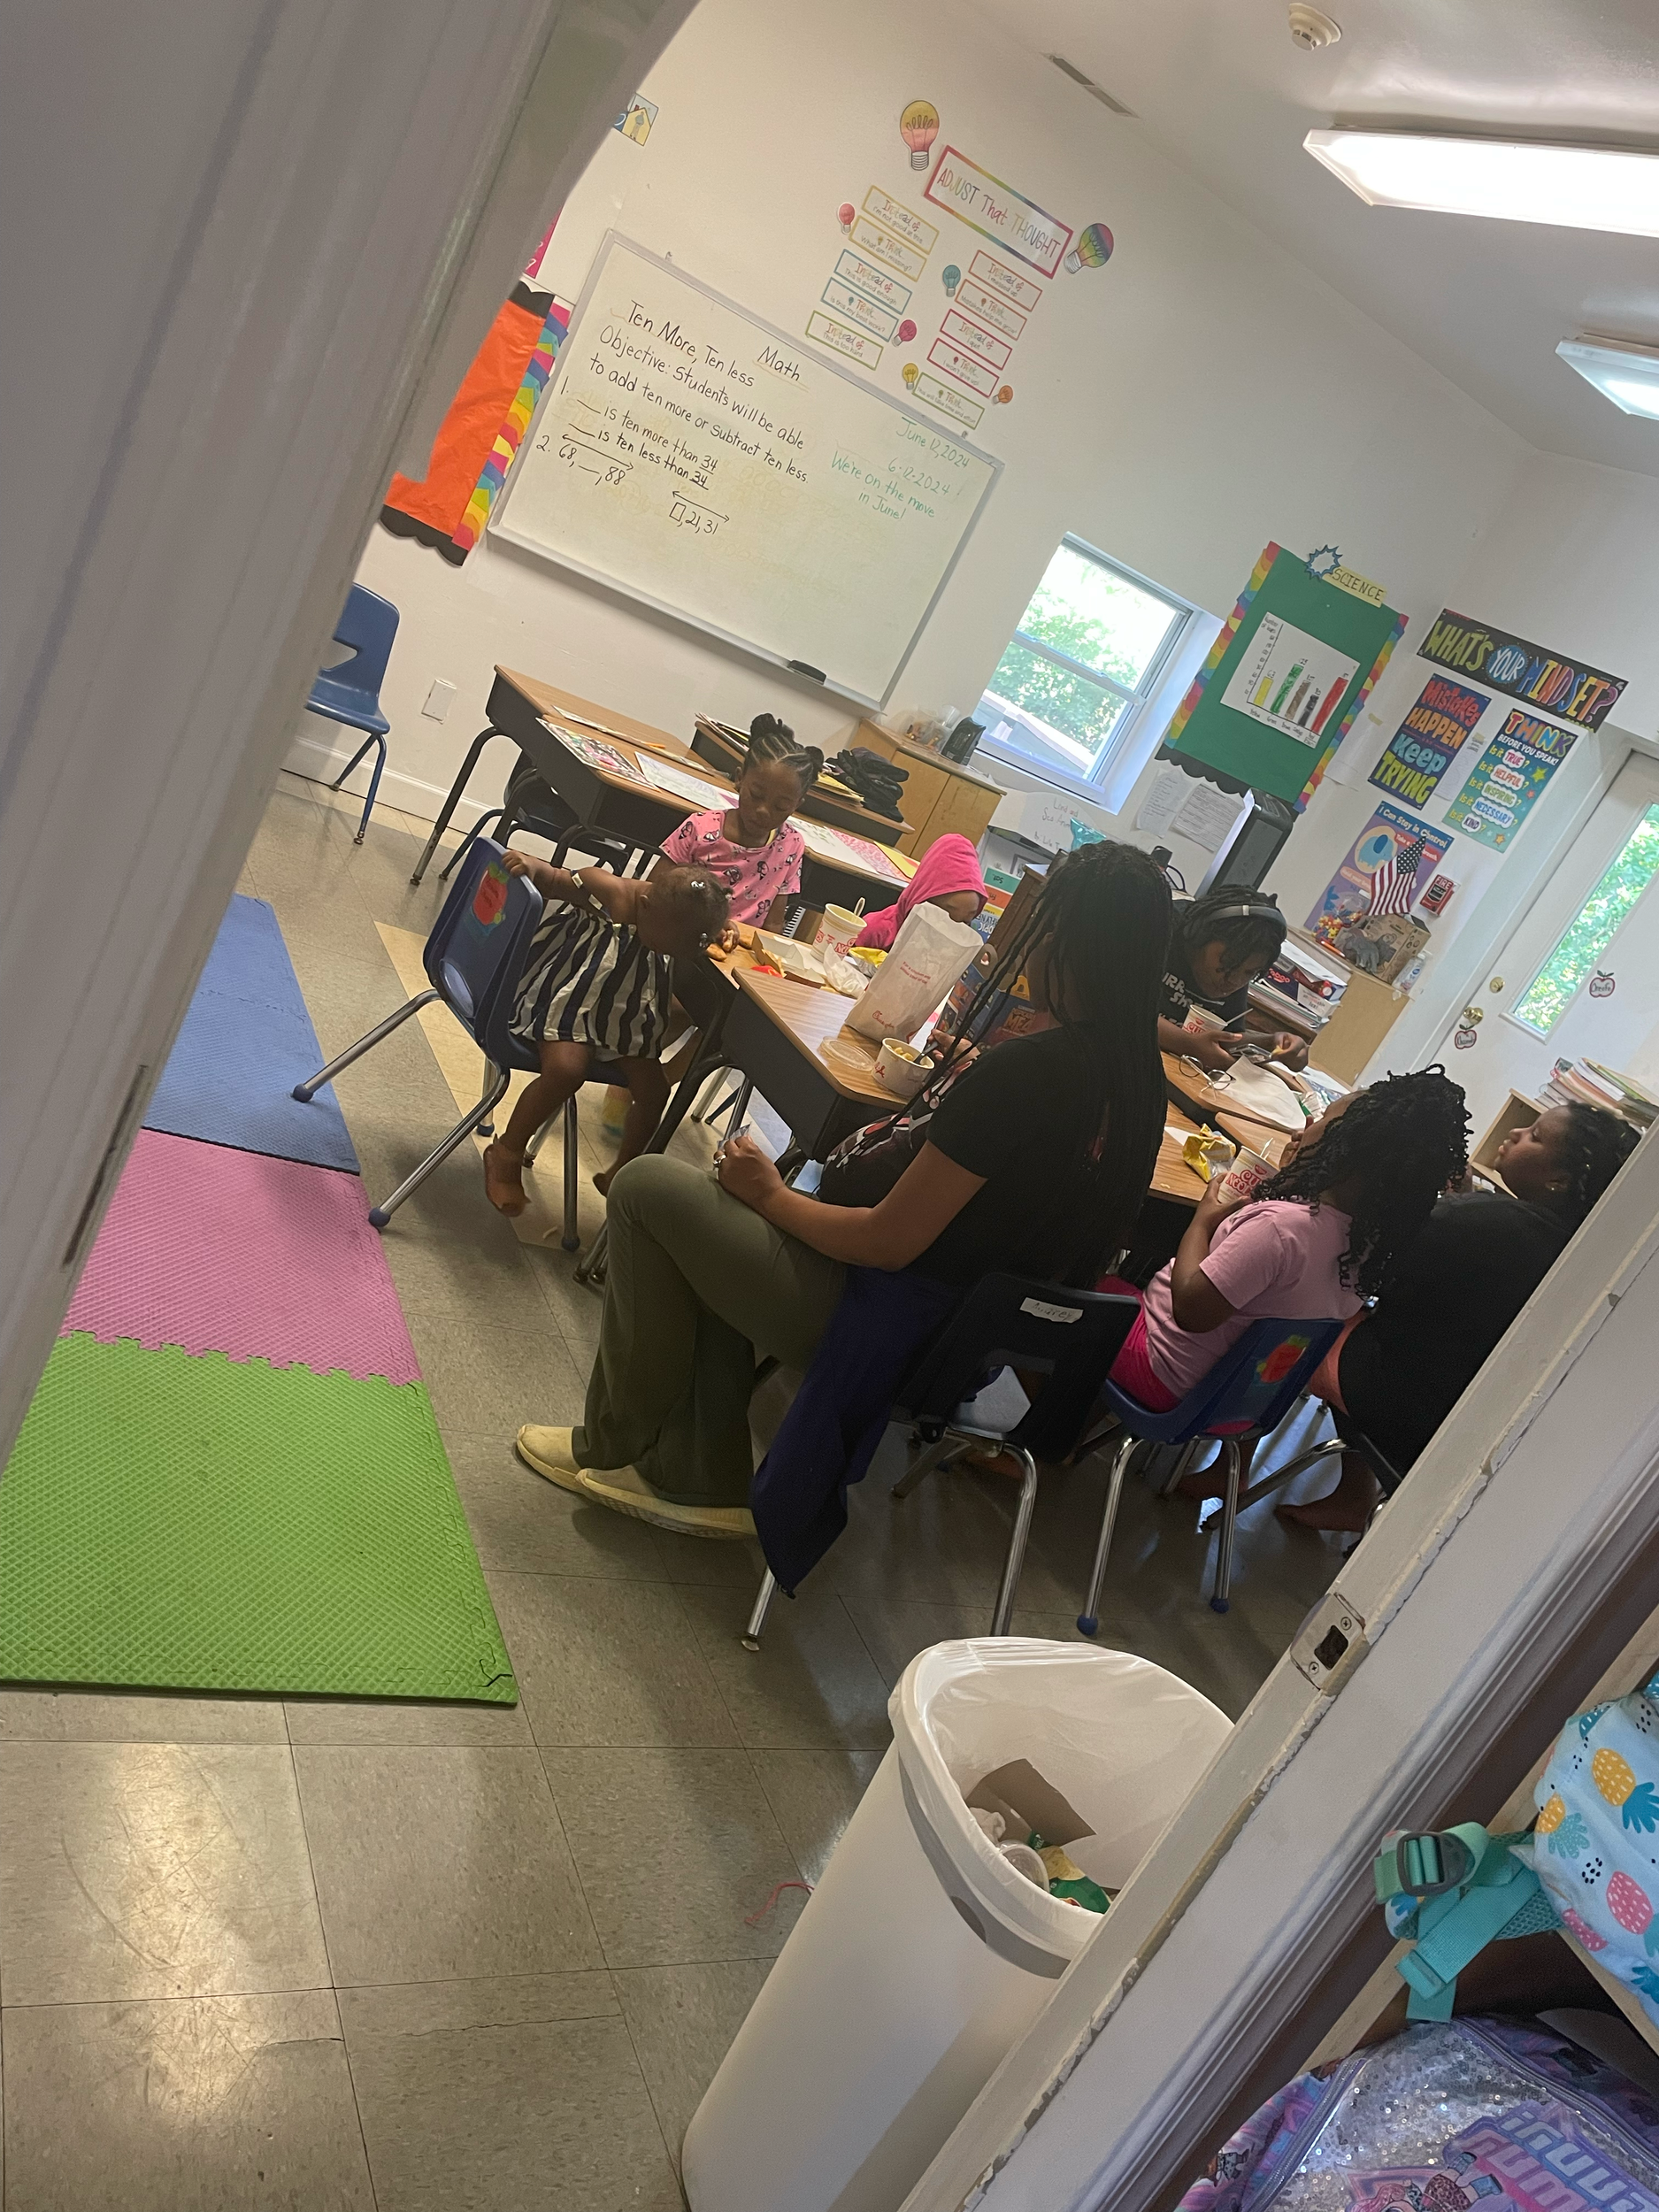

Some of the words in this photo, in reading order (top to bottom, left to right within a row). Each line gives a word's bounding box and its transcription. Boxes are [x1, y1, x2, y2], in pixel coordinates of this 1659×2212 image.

[937, 168, 980, 204] ADJUST
[981, 195, 1008, 226] That
[1010, 213, 1061, 258] THOUGHT
[861, 235, 875, 250] What
[861, 280, 877, 293] good
[876, 289, 897, 306] enough
[628, 300, 654, 333] Ten
[657, 321, 697, 364] More,
[704, 345, 725, 372] Ten
[727, 359, 755, 387] less
[757, 346, 801, 381] Math
[600, 325, 671, 374] Objective:
[672, 366, 729, 406] Students
[732, 401, 758, 422] will
[758, 412, 773, 432] be
[777, 427, 803, 449] able
[590, 353, 604, 374] to
[609, 372, 638, 392] add
[642, 382, 663, 405] ten
[664, 401, 692, 422] more
[695, 418, 709, 429] or
[764, 448, 782, 471] ten
[786, 458, 809, 483] less.
[895, 417, 926, 447] June
[604, 401, 618, 420] is
[622, 410, 639, 433] ten
[642, 428, 669, 448] more
[673, 438, 698, 463] than
[700, 455, 718, 472] 34
[598, 423, 611, 442] is
[617, 433, 634, 452] ten
[639, 442, 661, 465] less
[664, 455, 689, 479] than
[693, 471, 709, 488] 34
[831, 450, 862, 479] We're
[864, 473, 881, 488] on
[885, 480, 904, 502] the
[908, 495, 935, 518] move
[858, 488, 870, 504] in
[1332, 568, 1384, 601] SCIENCE
[1424, 620, 1494, 672] WHAT'S
[1489, 648, 1525, 681] YOUR
[1516, 657, 1619, 723] MINDSET?
[1405, 707, 1468, 749] HAPPEN
[1505, 712, 1575, 757] THINK
[1479, 761, 1486, 771] Is
[1489, 744, 1496, 755] Is
[1497, 733, 1522, 750] BEFORE
[1521, 744, 1535, 756] YOU
[1534, 750, 1560, 766] SPEAK!
[1373, 750, 1438, 804] TRYING
[1469, 777, 1477, 787] Is
[1449, 810, 1457, 818] Is
[1459, 794, 1467, 803] Is
[1383, 810, 1397, 821] Can
[1396, 816, 1412, 831] Stay
[1436, 877, 1451, 890] FIRE
